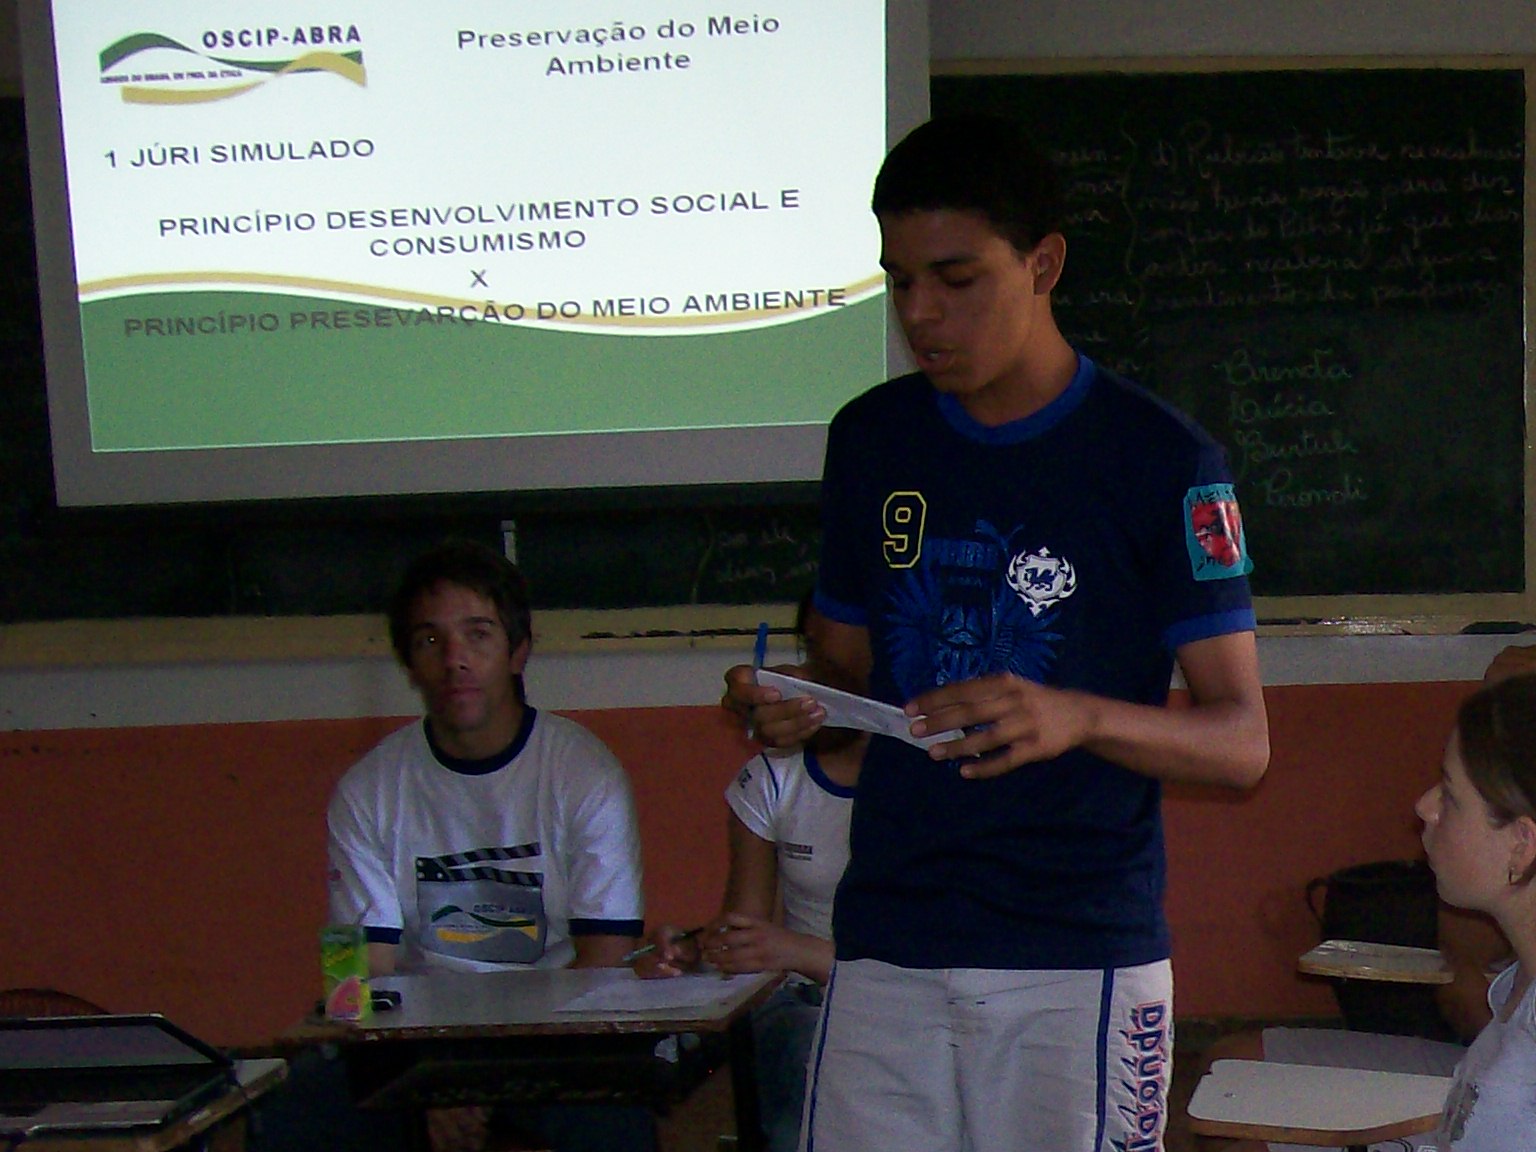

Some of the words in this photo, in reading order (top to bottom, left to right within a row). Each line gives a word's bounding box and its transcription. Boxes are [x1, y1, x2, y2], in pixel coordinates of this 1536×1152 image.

[202, 24, 362, 49] OSCIP-ABRA
[457, 21, 647, 51] Preservação
[656, 19, 696, 40] do
[706, 14, 781, 36] Meio
[545, 52, 692, 77] Ambiente
[103, 149, 117, 168] 1
[130, 141, 200, 168] JÚRI
[210, 138, 376, 164] SIMULADO
[158, 209, 317, 238] PRINCÍPIO
[326, 197, 640, 231] DESENVOLVIMENTO
[650, 189, 770, 215] SOCIAL
[780, 188, 800, 208] E
[369, 229, 587, 258] CONSUMISMO
[470, 268, 490, 289] X
[123, 310, 281, 338] PRINCÍPIO
[289, 298, 525, 332] PRESEVARÇÃO
[536, 300, 582, 320] DO
[592, 296, 671, 318] MEIO
[682, 287, 847, 314] AMBIENTE
